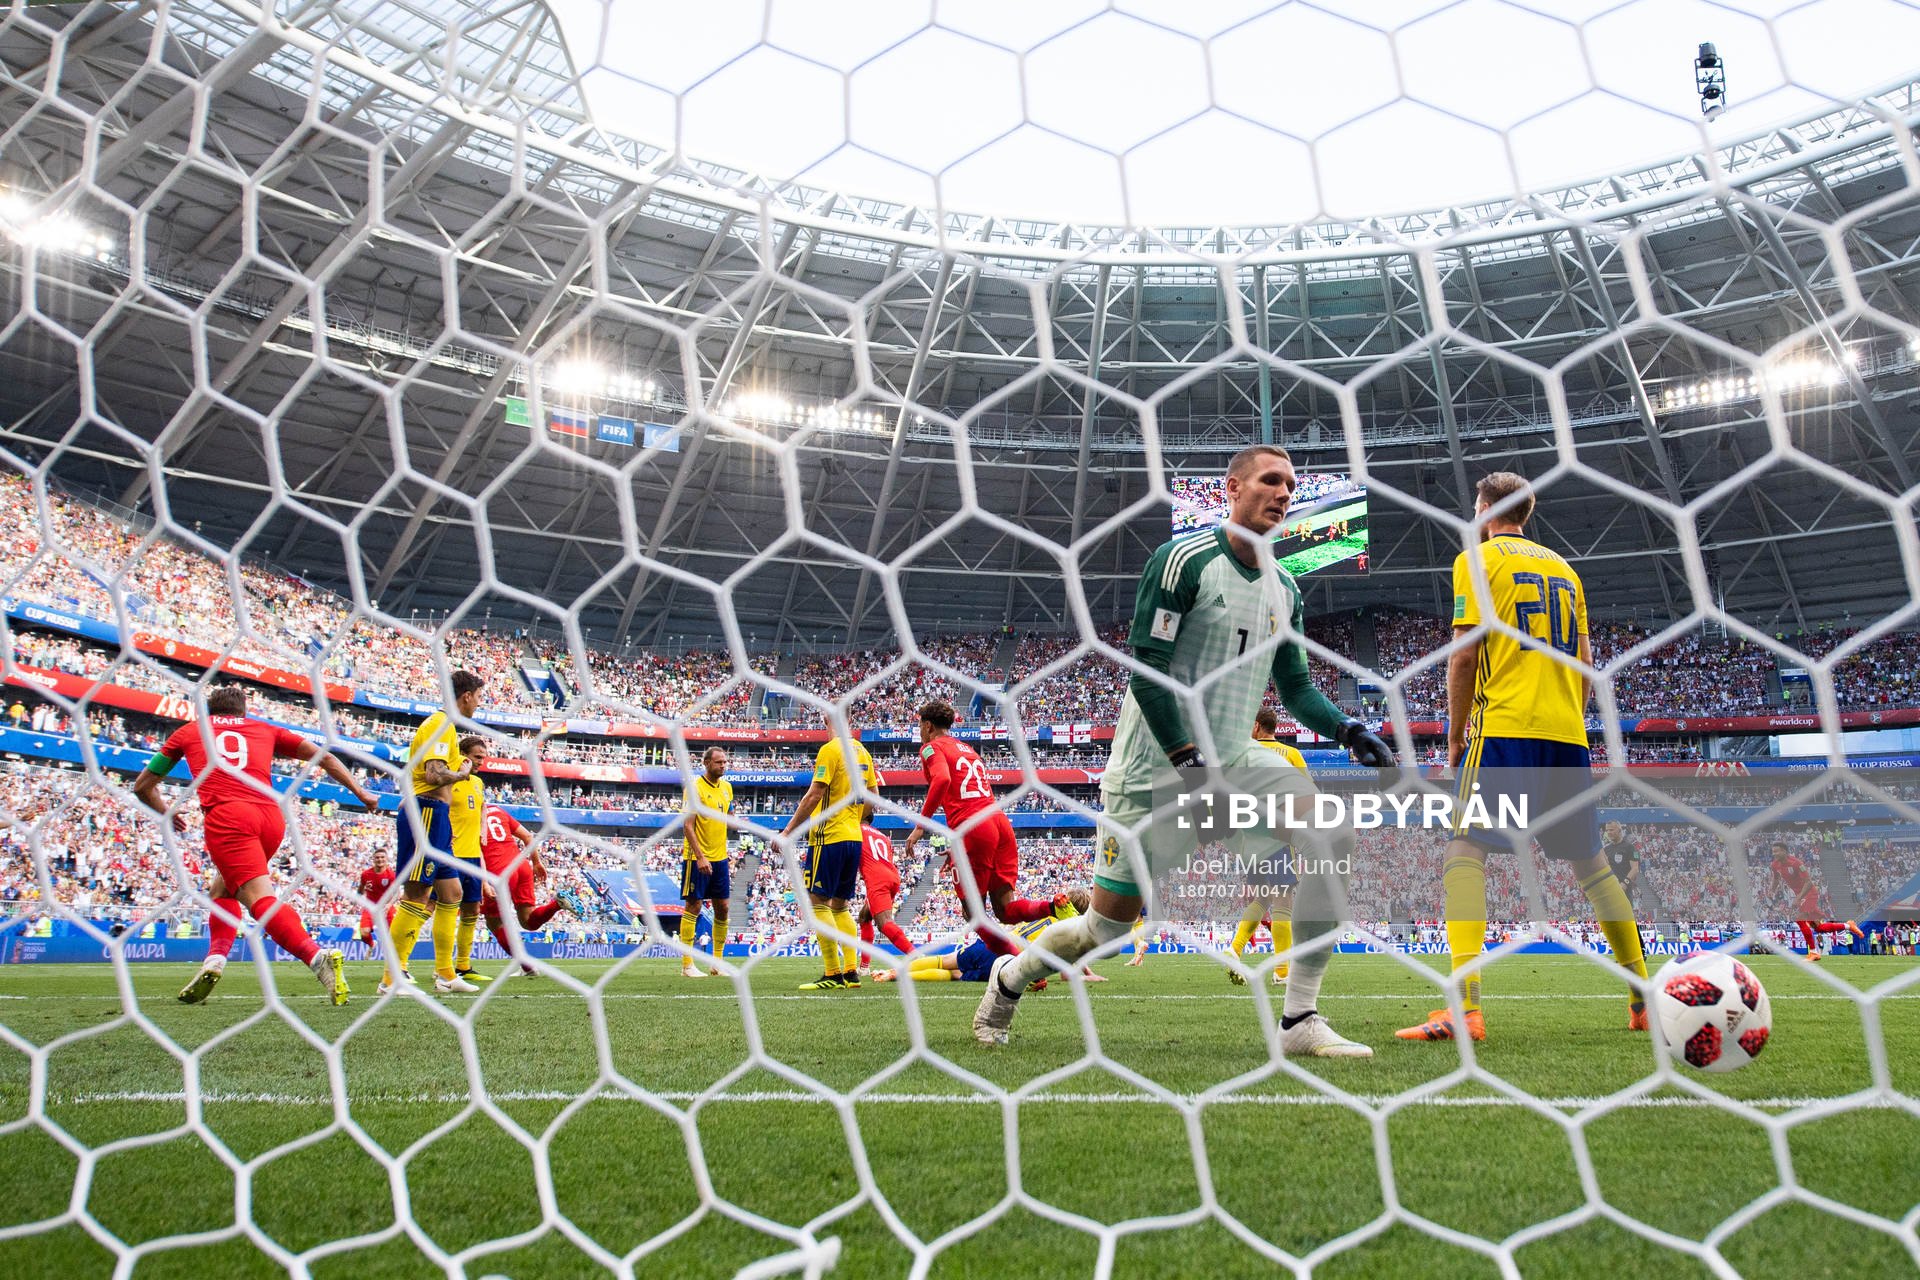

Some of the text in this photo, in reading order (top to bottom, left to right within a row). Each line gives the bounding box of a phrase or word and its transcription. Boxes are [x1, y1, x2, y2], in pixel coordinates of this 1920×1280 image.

[602, 424, 628, 437] FIFA
[1512, 571, 1578, 658] 20
[1237, 627, 1248, 669] 1
[1769, 717, 1814, 726] #worldcup
[717, 730, 759, 740] #worldcup
[215, 730, 248, 771] 9
[1788, 764, 1807, 772] 2018
[1808, 762, 1826, 771] FIFA
[1860, 761, 1878, 769] CUP
[1880, 759, 1912, 768] RUSSIA
[748, 774, 765, 783] CUP
[766, 774, 795, 783] RUSSIA
[956, 756, 990, 799] 20
[1321, 769, 1338, 777] 2018
[1347, 769, 1379, 777] РОССИИ
[468, 795, 475, 809] 8
[868, 835, 890, 862] 10
[103, 943, 165, 959] СМАРА
[584, 943, 614, 958] WANDA
[1644, 942, 1703, 954] WANDA
